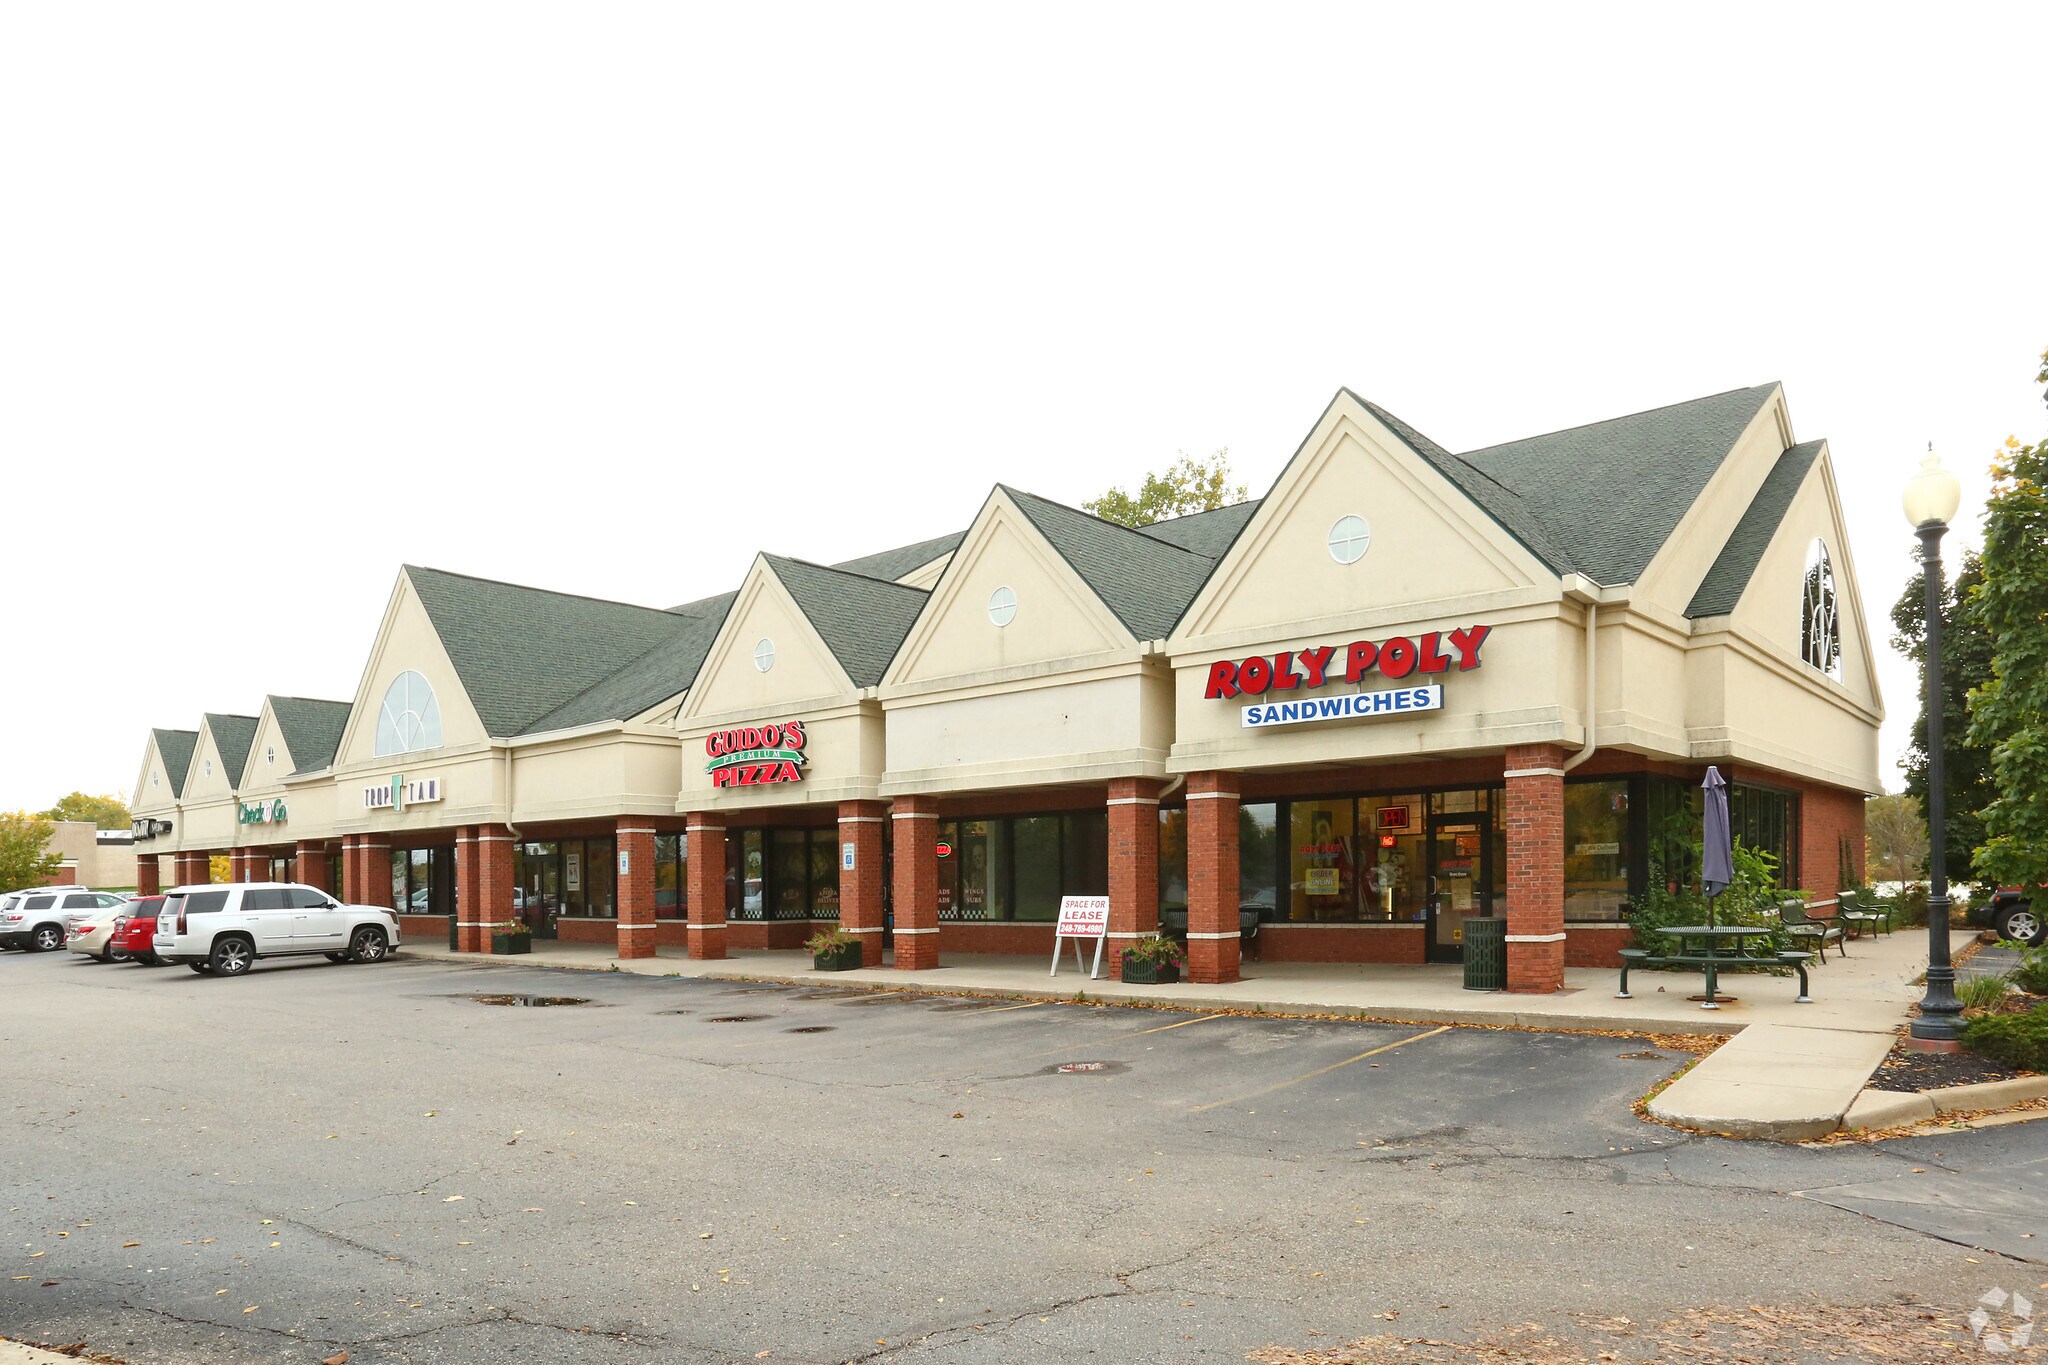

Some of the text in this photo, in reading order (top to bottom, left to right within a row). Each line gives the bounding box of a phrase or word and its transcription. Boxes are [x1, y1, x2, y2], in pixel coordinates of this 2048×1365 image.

[1204, 625, 1492, 700] ROLY POLY
[1246, 688, 1431, 724] SANDWICHES
[705, 720, 805, 757] GUIDO'S
[723, 750, 781, 764] PREMIUM
[712, 761, 801, 788] PIZZA
[409, 780, 436, 802] TAN
[274, 798, 287, 821] Go
[1378, 809, 1407, 825] OPEN
[1065, 900, 1106, 908] SPACE FOR
[1064, 911, 1103, 920] LEASE
